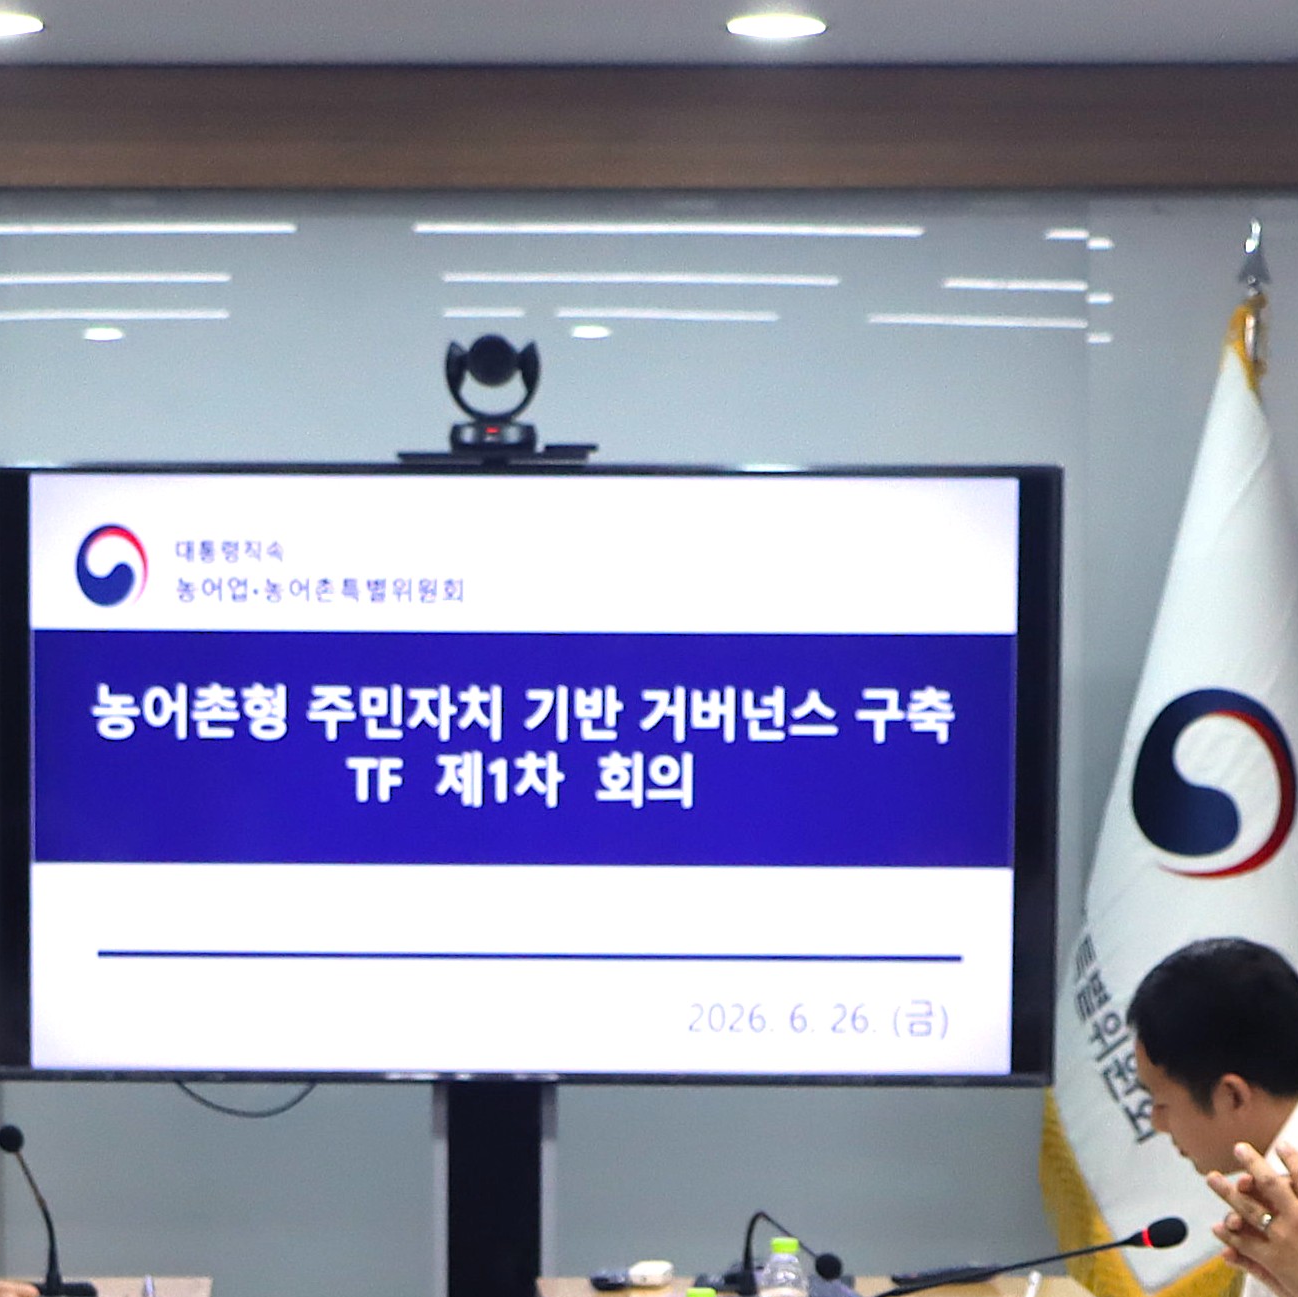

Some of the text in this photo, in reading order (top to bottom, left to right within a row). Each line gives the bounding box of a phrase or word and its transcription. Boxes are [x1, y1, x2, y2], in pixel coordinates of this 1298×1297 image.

[175, 540, 284, 563] 대통령직속
[92, 682, 956, 744] 농어촌형 주민자치 기반 거버넌스 구축
[346, 750, 694, 809] TF 제1차 회의
[688, 999, 949, 1040] 2026. 6. 26. (금)
